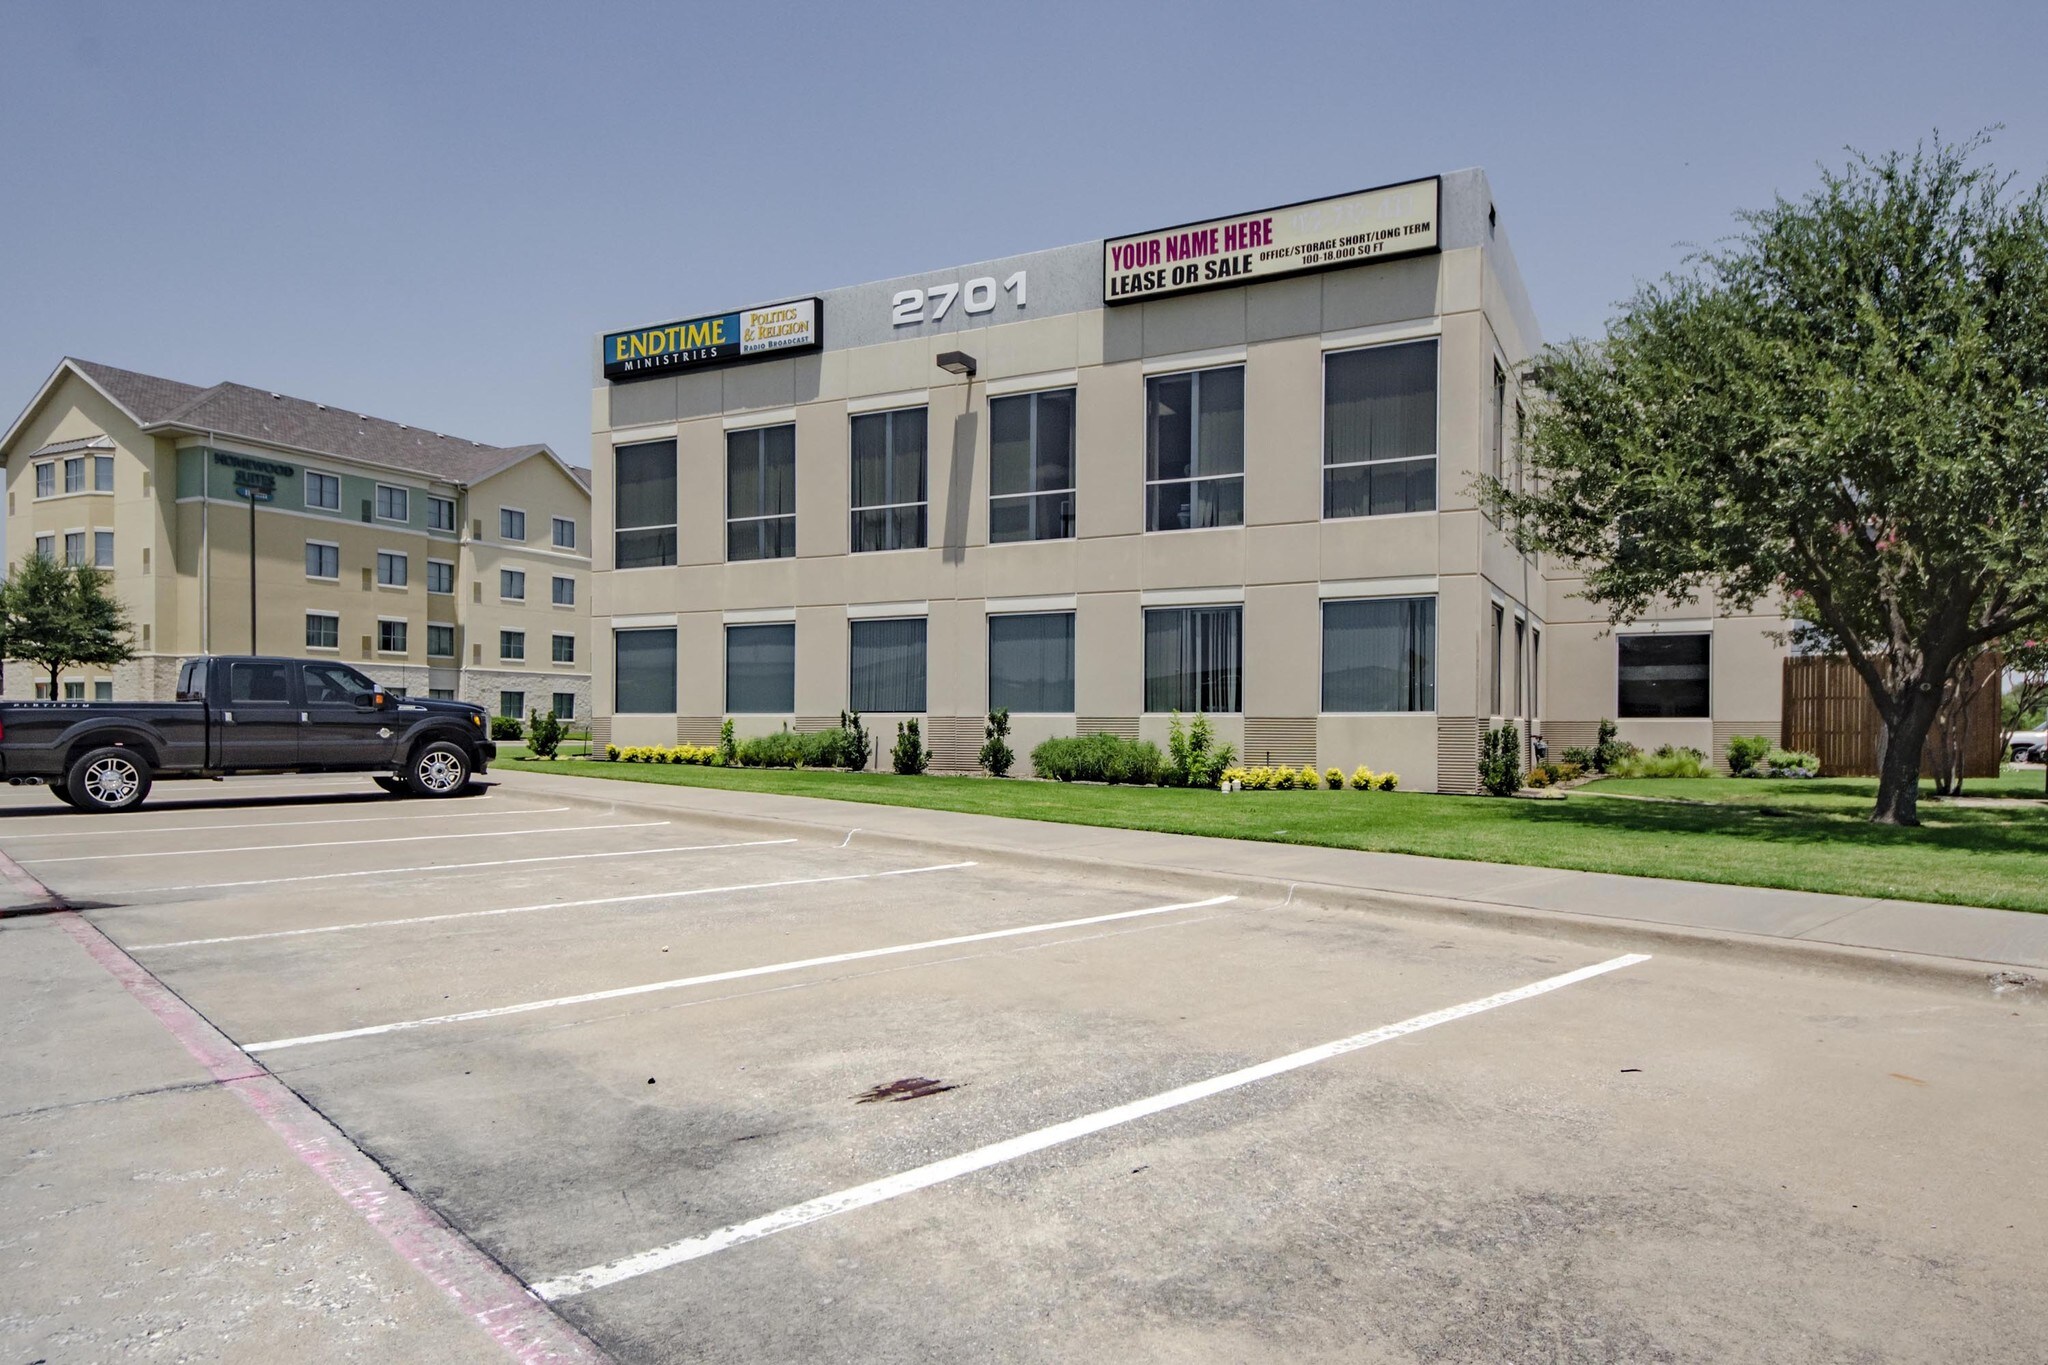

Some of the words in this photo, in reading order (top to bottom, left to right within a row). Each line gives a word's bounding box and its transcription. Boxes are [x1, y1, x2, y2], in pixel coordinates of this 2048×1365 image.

[1111, 239, 1161, 271] YOUR
[1166, 228, 1219, 262] NAME
[1224, 218, 1273, 252] HERE
[1259, 239, 1337, 261] OFFICE/STORAGE
[1339, 227, 1401, 247] SHORT/LONG
[1403, 221, 1431, 235] TERM
[1357, 244, 1371, 255] SQ
[1373, 241, 1384, 252] FT
[1111, 269, 1166, 296] LEASE
[1172, 264, 1199, 285] OR
[1204, 254, 1253, 280] SALE
[892, 270, 1027, 328] 2701
[743, 327, 755, 342] &
[757, 320, 809, 339] RELIGION
[750, 308, 797, 326] POLITICS
[616, 319, 726, 361] ENDTIME
[743, 344, 766, 352] RADIO
[768, 336, 809, 348] BROADCAST
[624, 347, 718, 371] MINISTRIES
